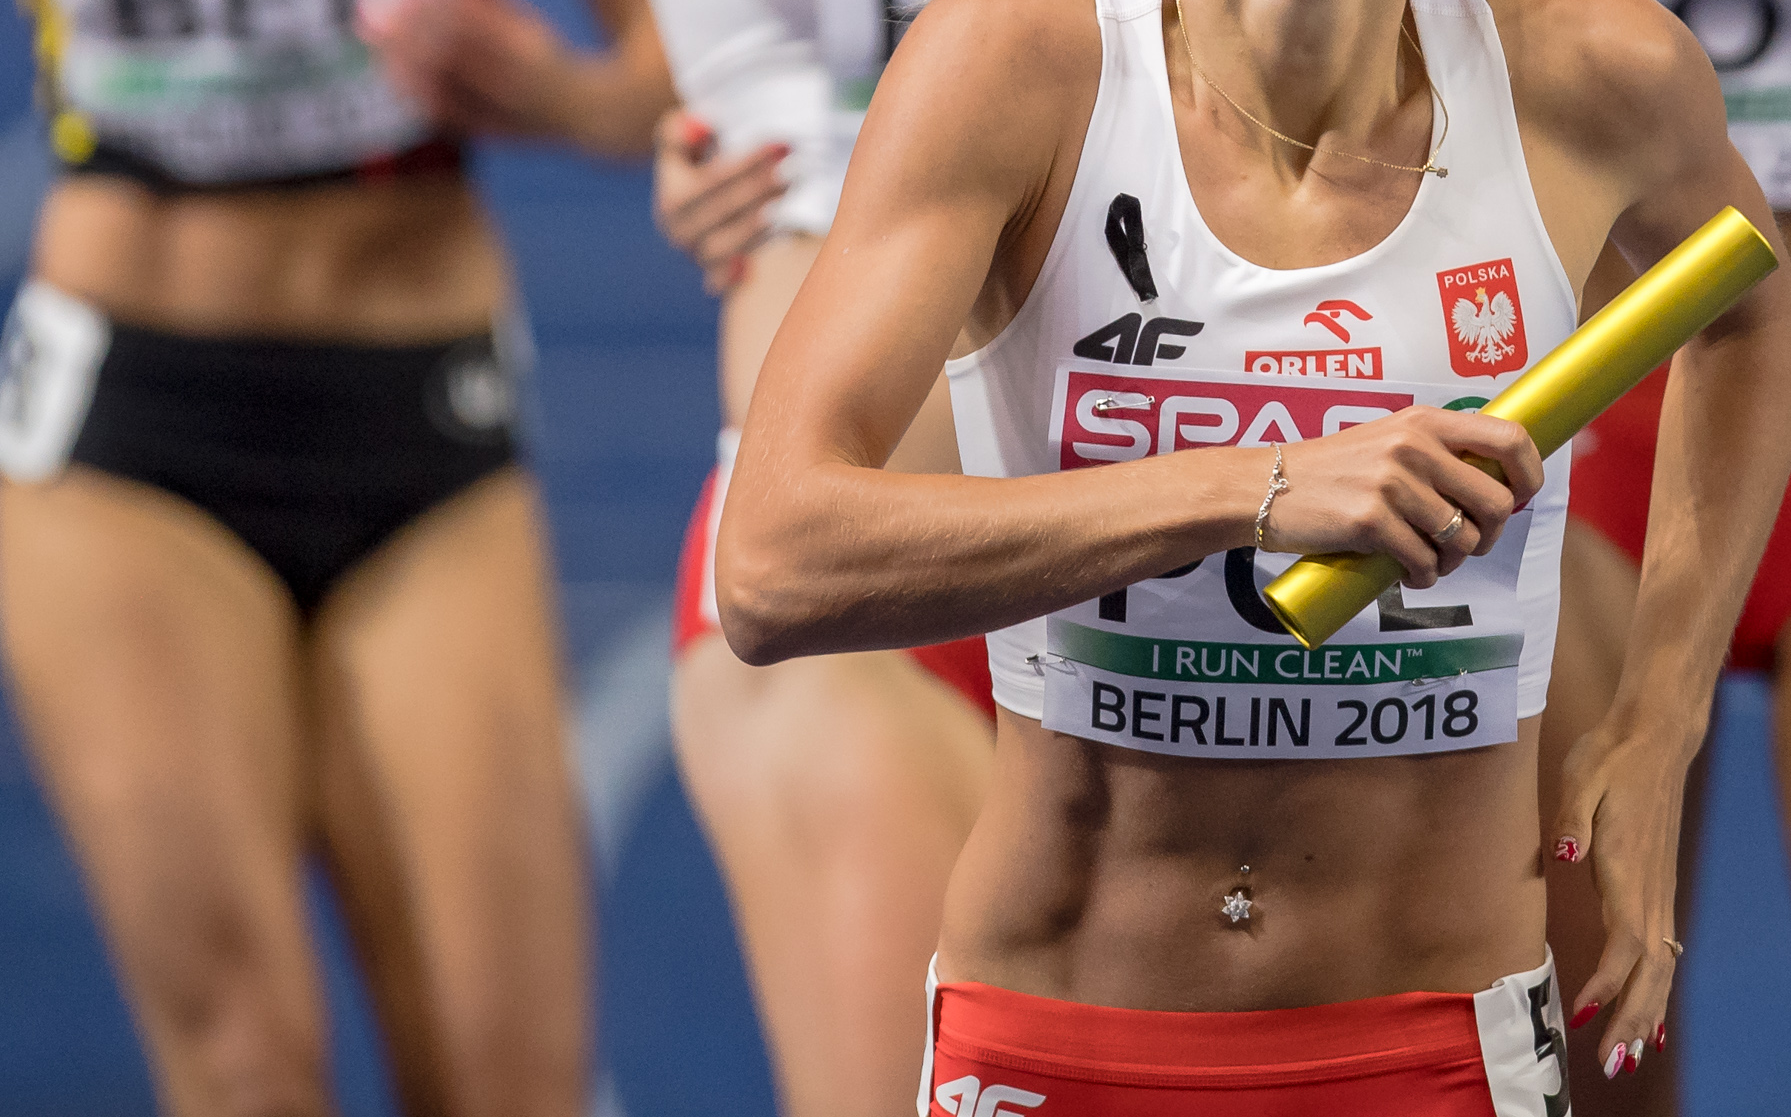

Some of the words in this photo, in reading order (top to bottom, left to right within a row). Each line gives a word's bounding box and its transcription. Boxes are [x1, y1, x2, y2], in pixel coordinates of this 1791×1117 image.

[1443, 264, 1510, 289] POLSKA
[1073, 312, 1205, 366] 4F
[1252, 353, 1374, 378] ORLEN
[1152, 644, 1160, 672] I
[1175, 649, 1259, 678] RUN
[1091, 680, 1311, 747] BERLIN
[1334, 689, 1479, 744] 2018
